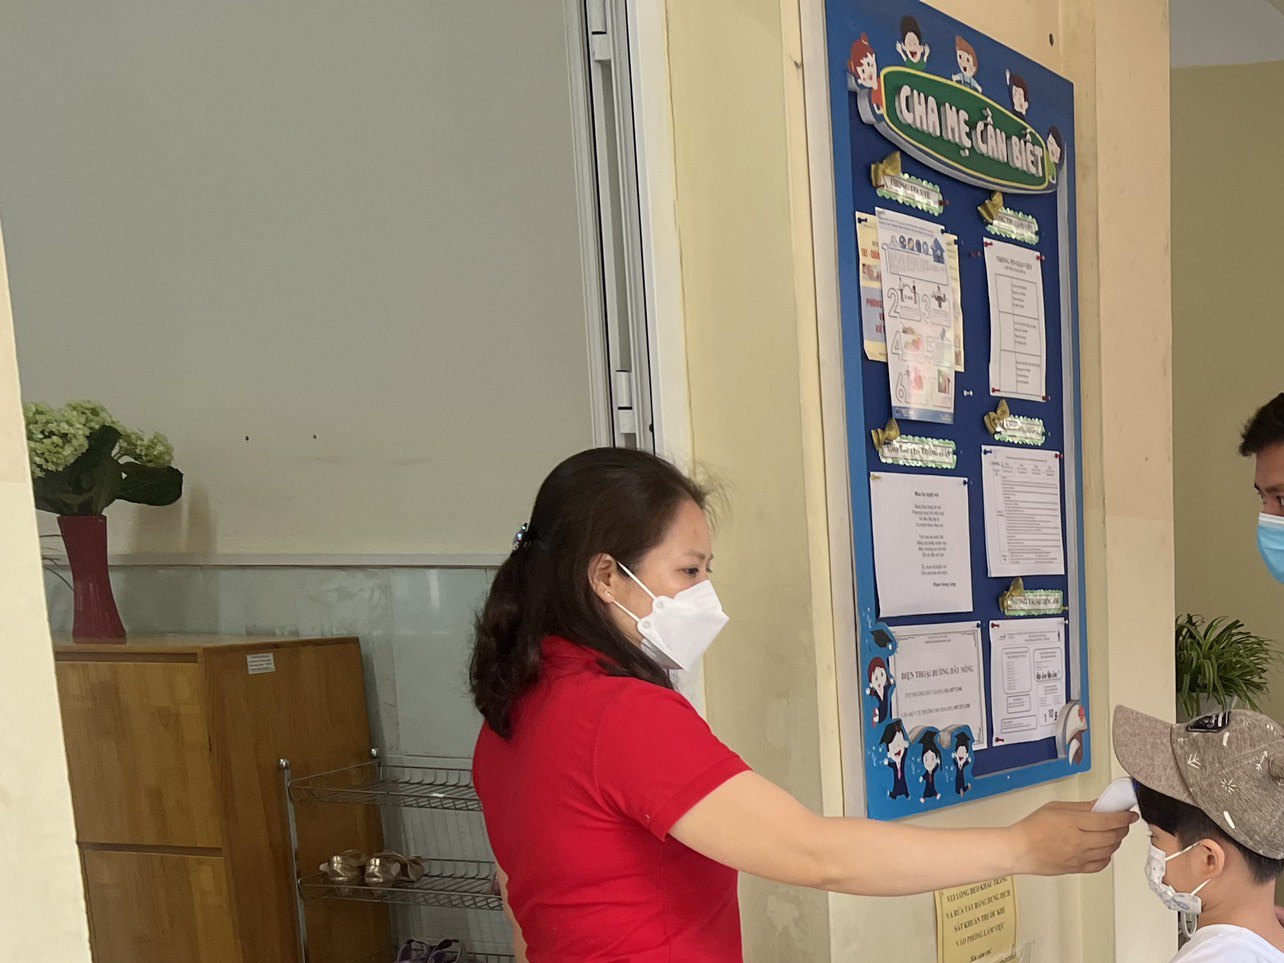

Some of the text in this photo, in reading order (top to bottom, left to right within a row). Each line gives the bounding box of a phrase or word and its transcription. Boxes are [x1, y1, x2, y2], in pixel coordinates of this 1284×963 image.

[899, 84, 941, 137] CHA
[944, 102, 972, 157] MẸ
[975, 107, 1008, 163] CẦN
